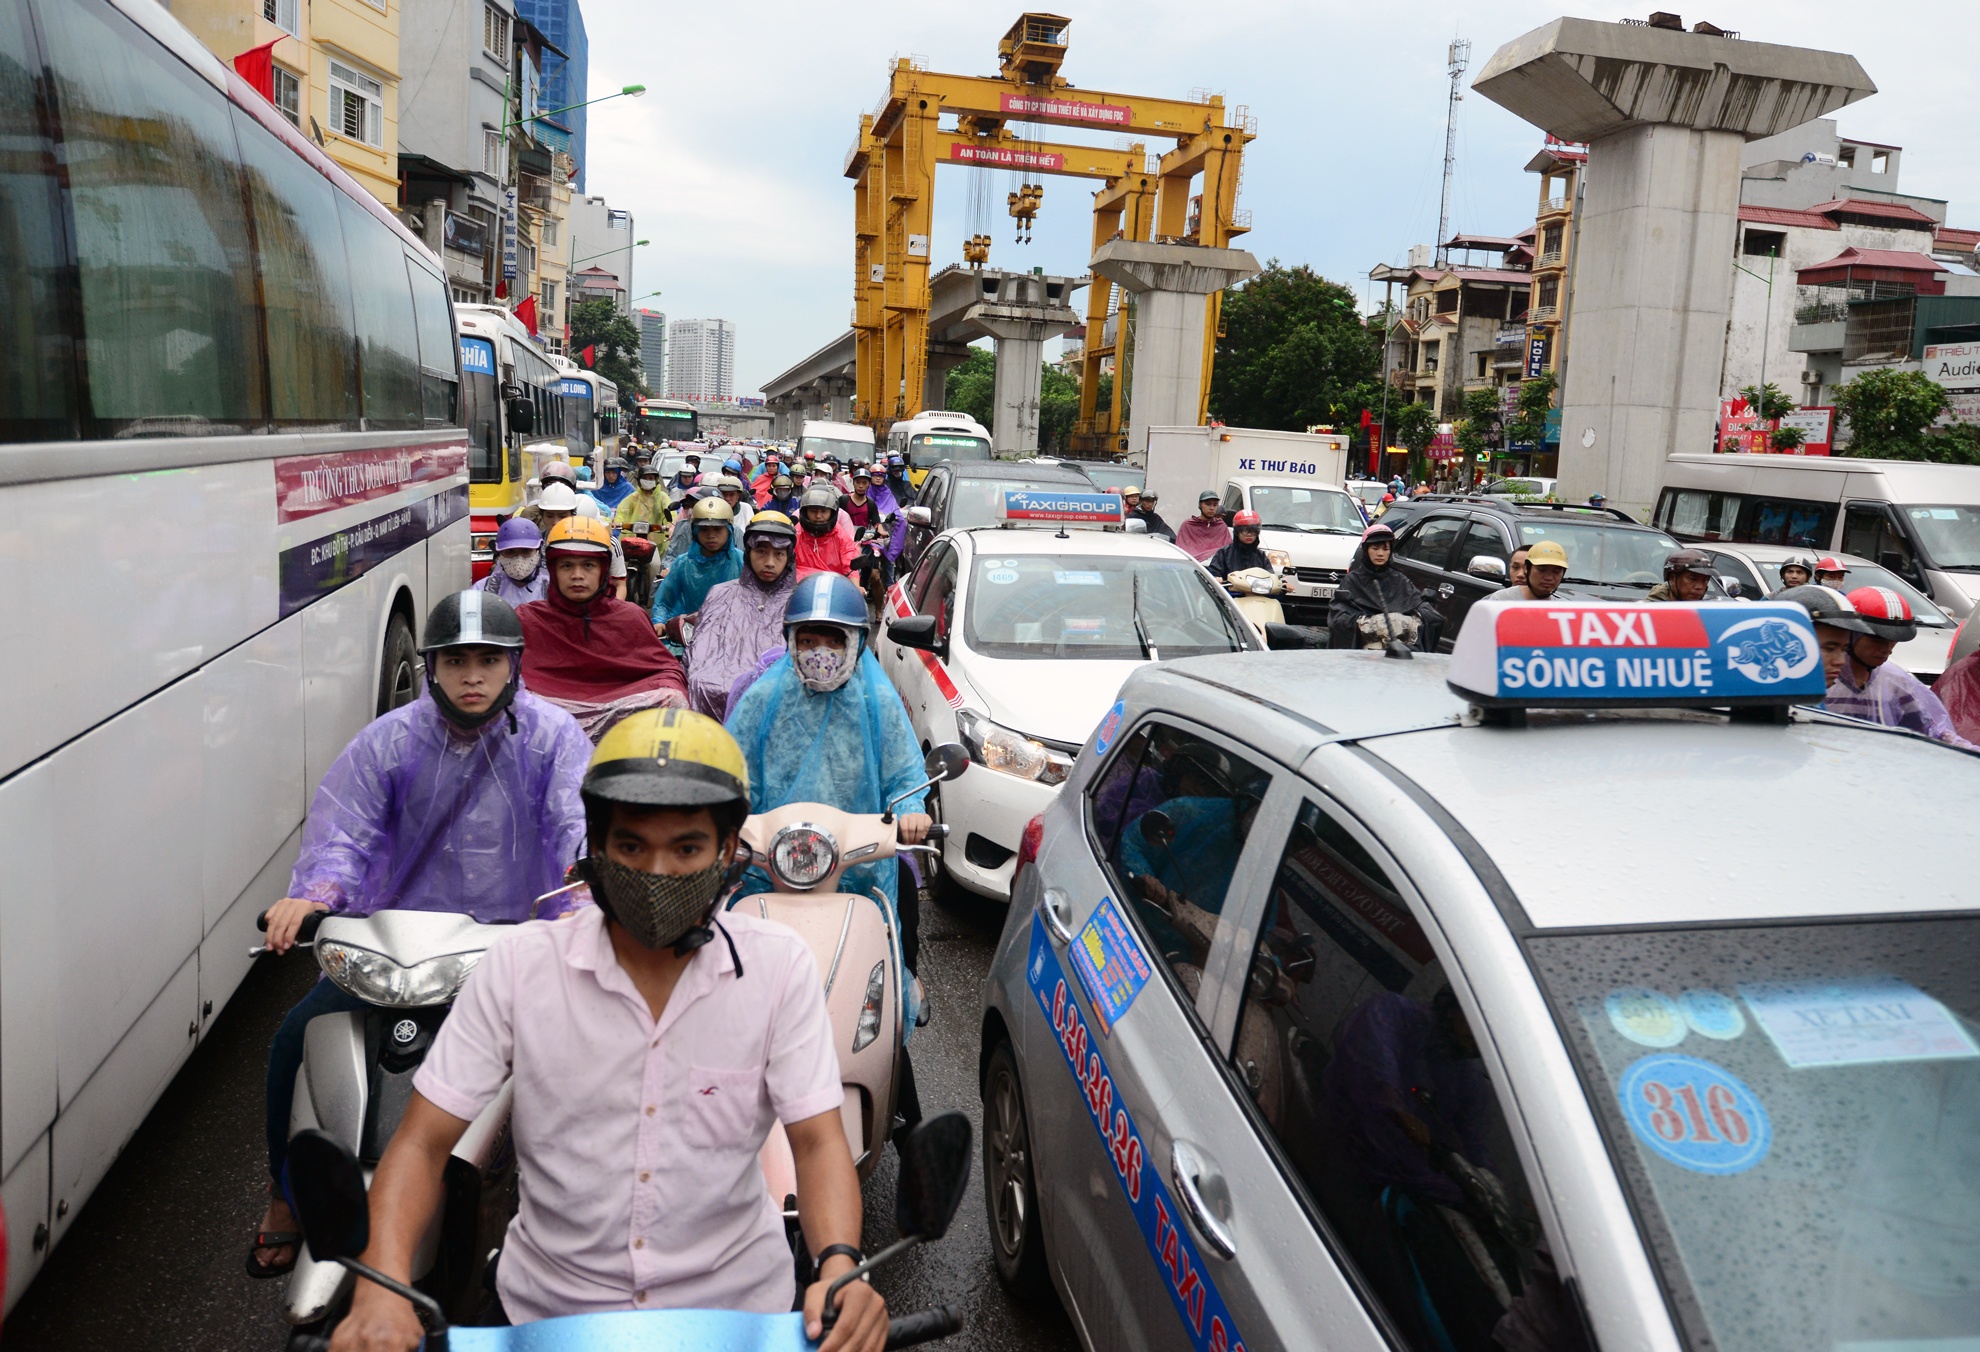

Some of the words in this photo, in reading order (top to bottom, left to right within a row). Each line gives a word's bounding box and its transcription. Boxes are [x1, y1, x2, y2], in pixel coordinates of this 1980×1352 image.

[1072, 103, 1080, 116] KẾ
[1080, 106, 1087, 117] VÀ
[1088, 106, 1098, 118] XÂY
[960, 149, 972, 158] AN
[976, 149, 998, 160] TOÀN
[1001, 150, 1012, 162] LÀ
[1014, 152, 1036, 164] TRÊN
[1039, 154, 1056, 166] HẾT
[1531, 340, 1543, 377] HOTEL
[1938, 346, 1972, 357] TRIỆU
[570, 383, 586, 394] LONG
[1239, 458, 1256, 470] XE
[1260, 460, 1287, 472] THƯ
[1290, 460, 1316, 474] BÁO
[301, 460, 342, 504] TRƯỜNG
[343, 464, 365, 495] THCS
[1020, 500, 1116, 512] TAXIGROUP
[1029, 512, 1097, 520] www.taxigroup.com.vn
[322, 541, 332, 560] KHU
[1548, 612, 1658, 646] TAXI
[1503, 650, 1605, 688] SÔNG
[1617, 650, 1713, 694] NHUỆ
[1793, 1007, 1836, 1028] XE
[1848, 1002, 1914, 1025] TAXI
[1643, 1082, 1750, 1146] 316
[1052, 978, 1142, 1203] 6.26.26.26
[1154, 1193, 1206, 1338] TAXI
